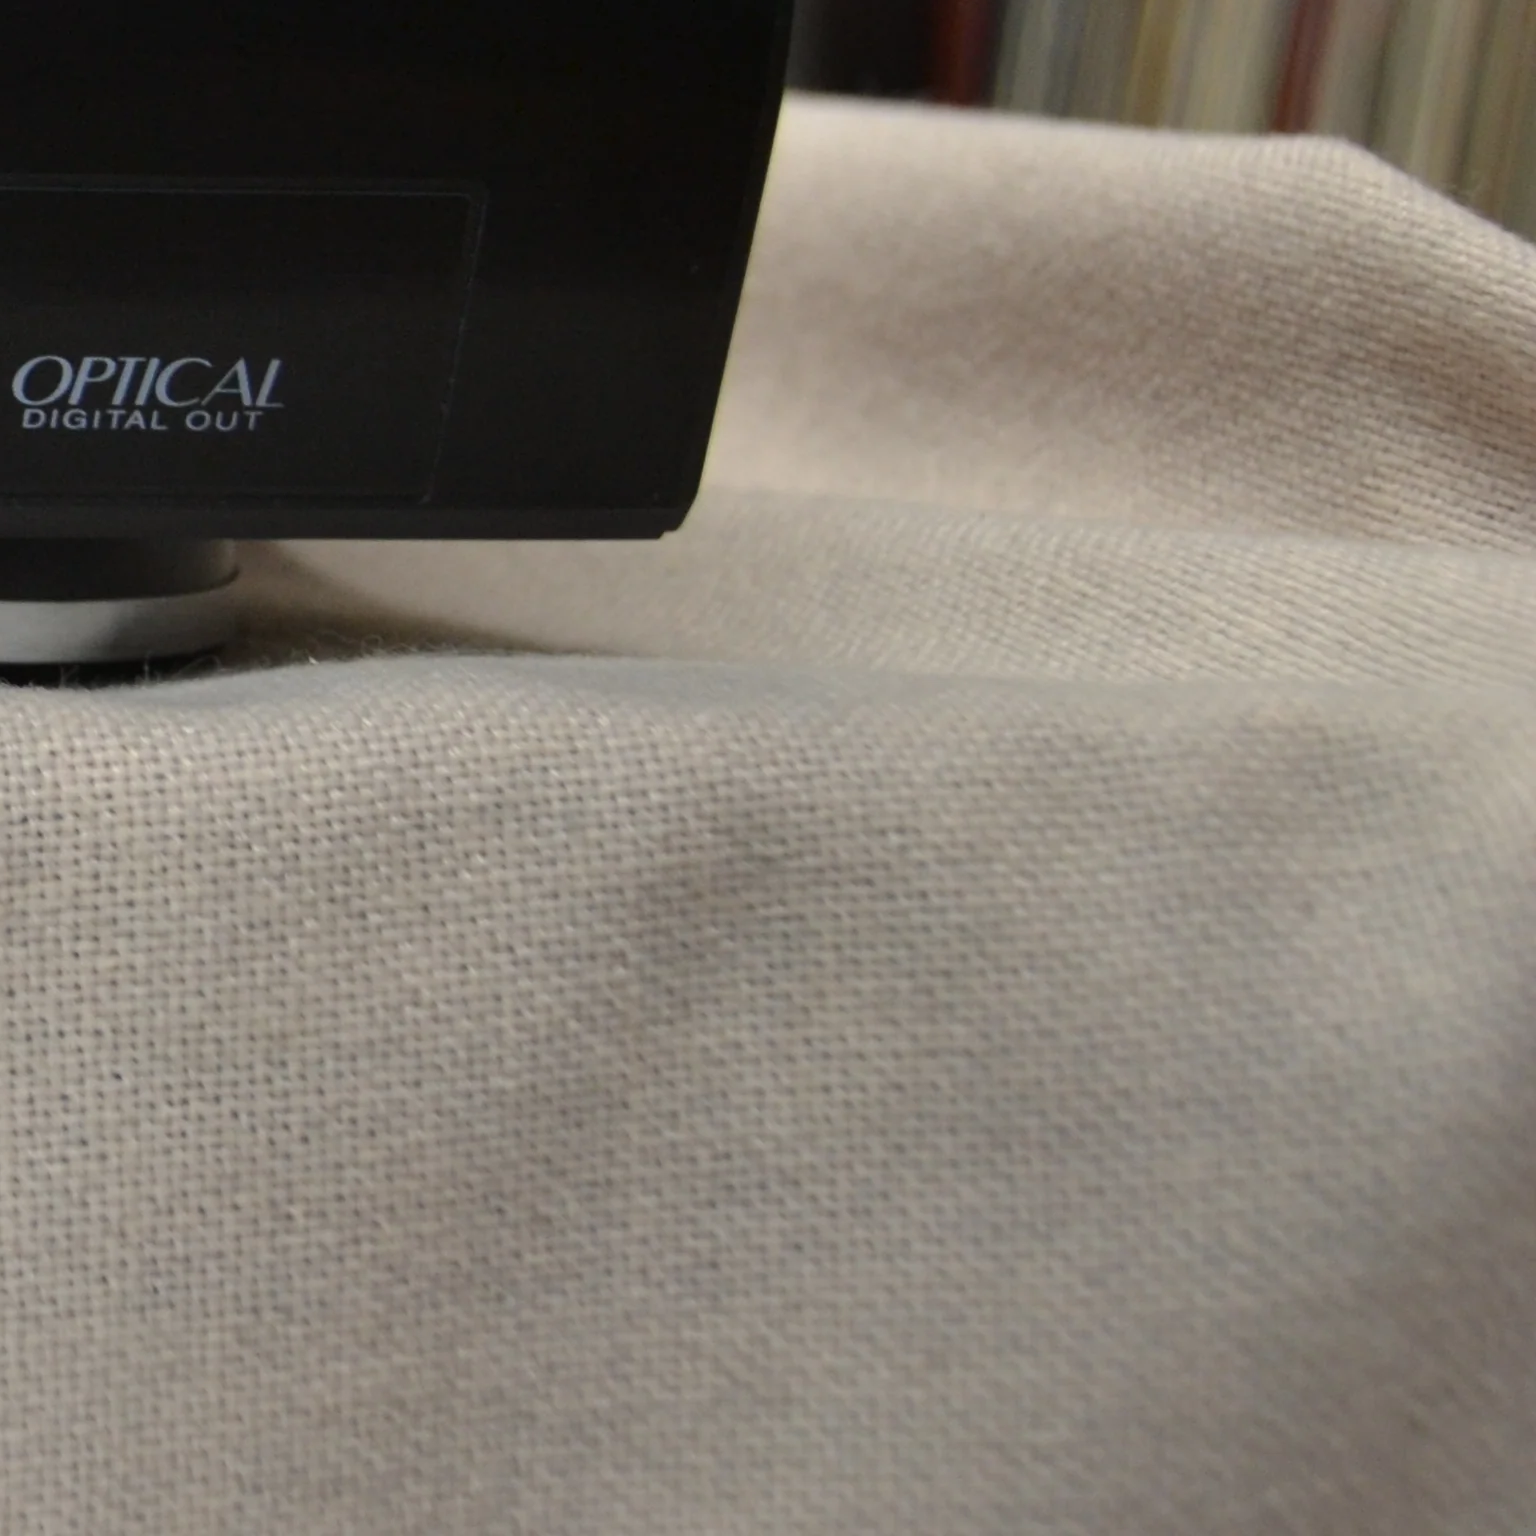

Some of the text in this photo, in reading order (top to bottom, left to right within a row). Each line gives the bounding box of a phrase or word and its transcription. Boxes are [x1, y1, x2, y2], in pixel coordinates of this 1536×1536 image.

[11, 354, 285, 408] OPTICAL
[21, 408, 263, 432] DIGITAL OUT
